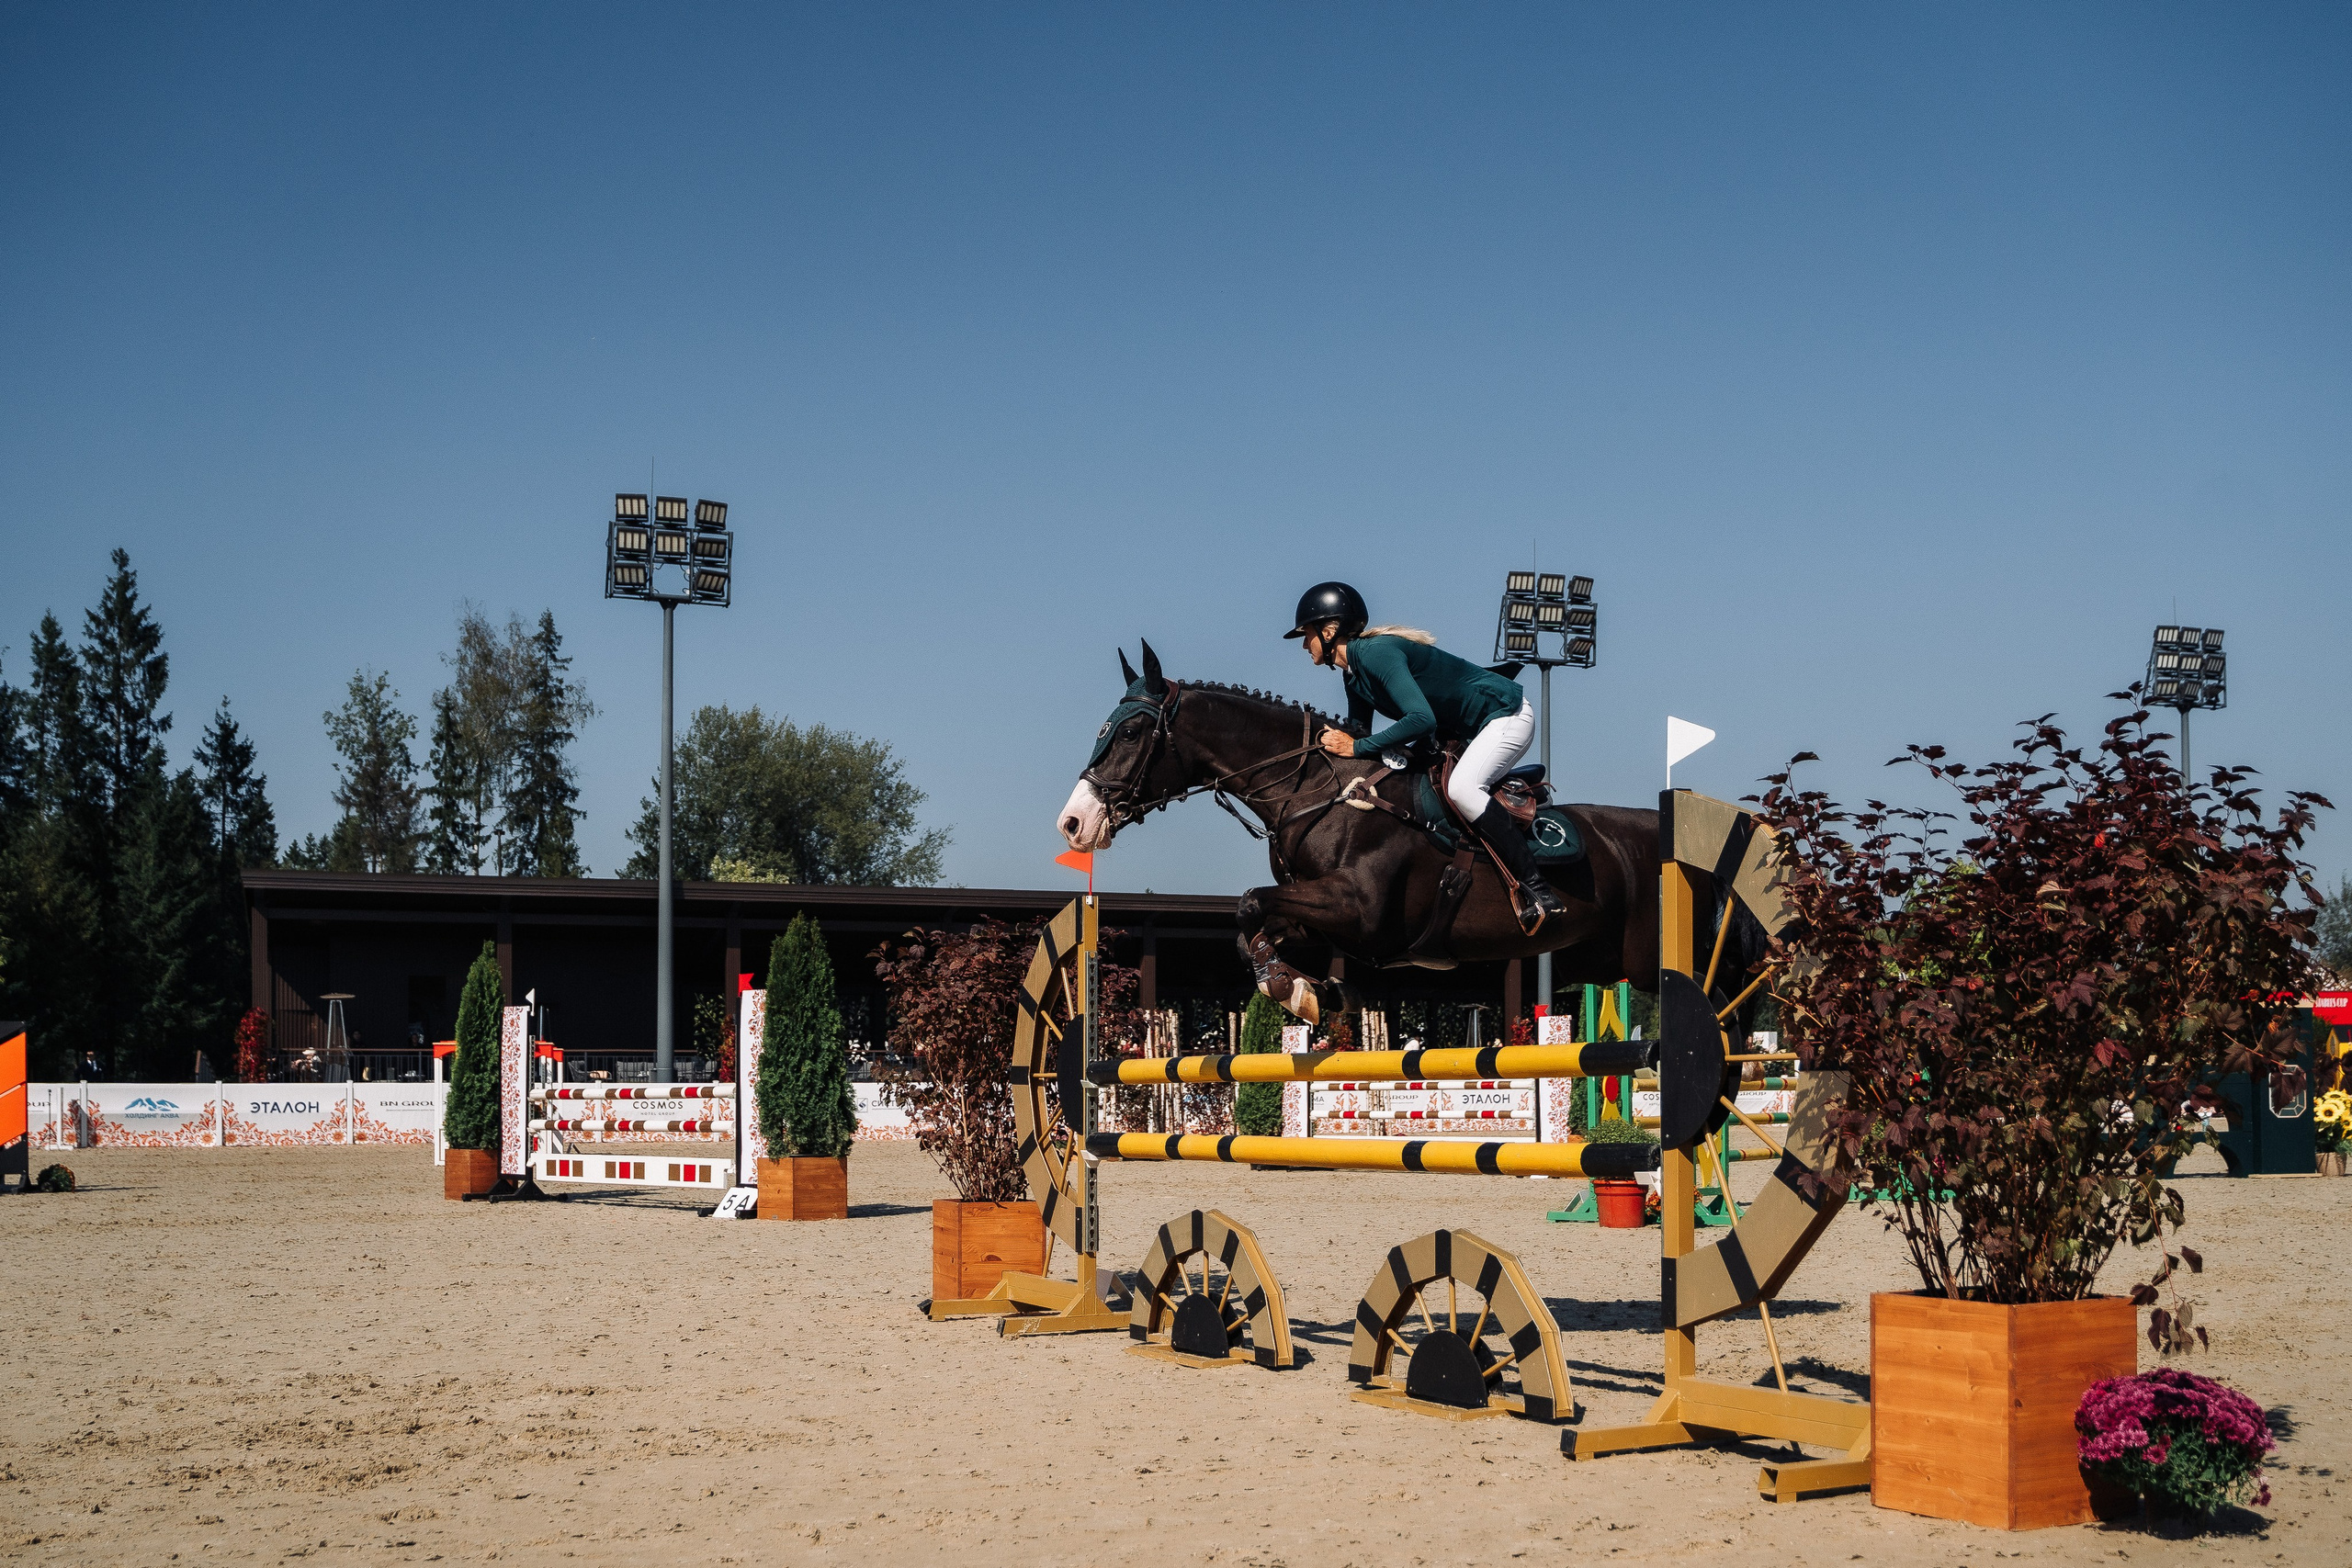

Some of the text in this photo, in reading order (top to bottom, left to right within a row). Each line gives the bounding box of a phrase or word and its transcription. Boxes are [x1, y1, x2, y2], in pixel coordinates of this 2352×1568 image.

[1462, 1094, 1510, 1104] ЭТАЛОН
[250, 1101, 320, 1113] ЭТАЛОН
[632, 1100, 684, 1110] COSMOS
